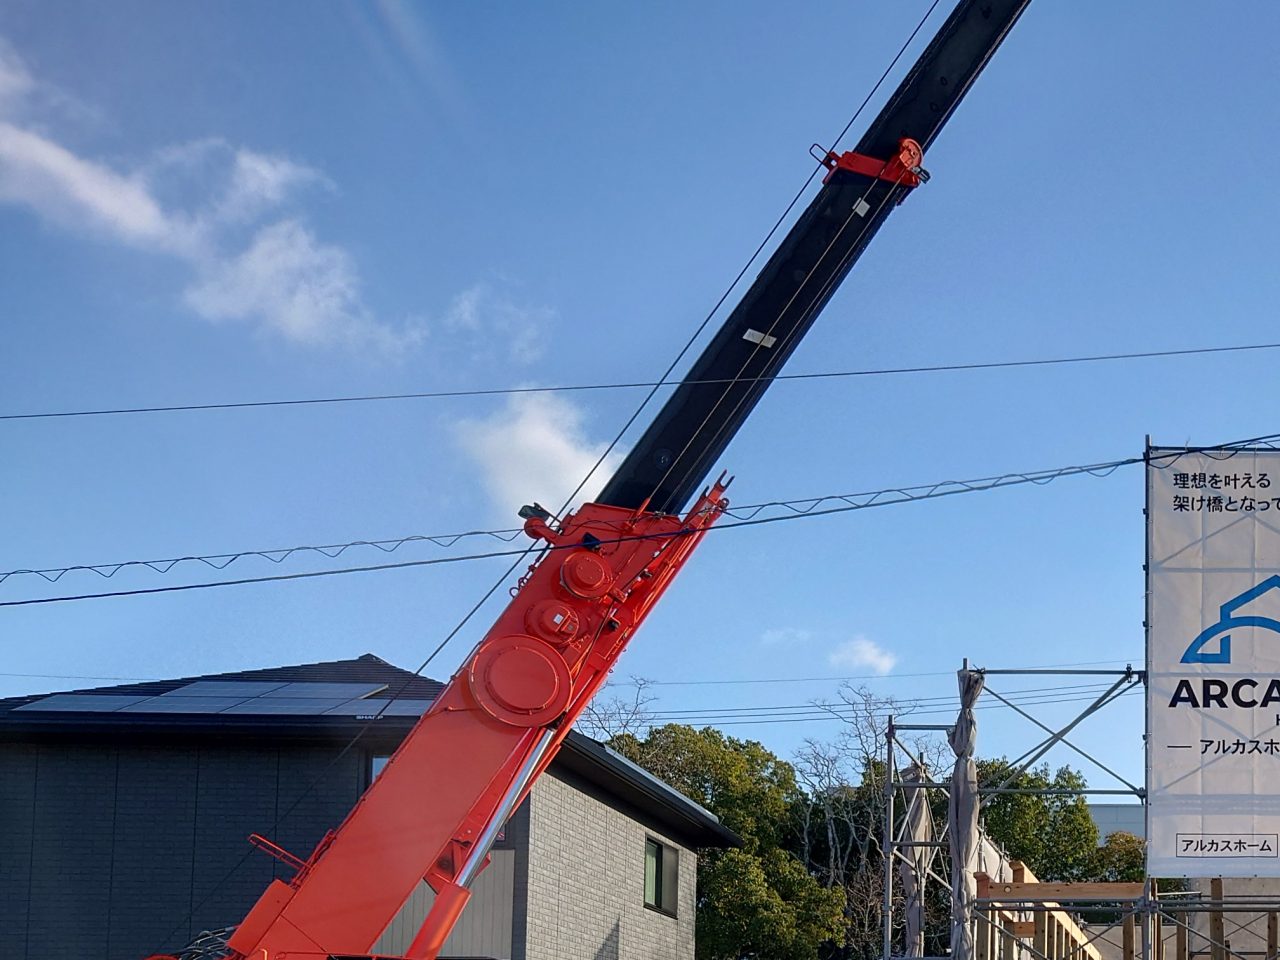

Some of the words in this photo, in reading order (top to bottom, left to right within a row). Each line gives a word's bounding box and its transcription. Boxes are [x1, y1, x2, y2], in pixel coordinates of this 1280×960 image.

[1173, 473, 1271, 489] 理想を叶える
[1181, 839, 1272, 852] アルカスホーム
